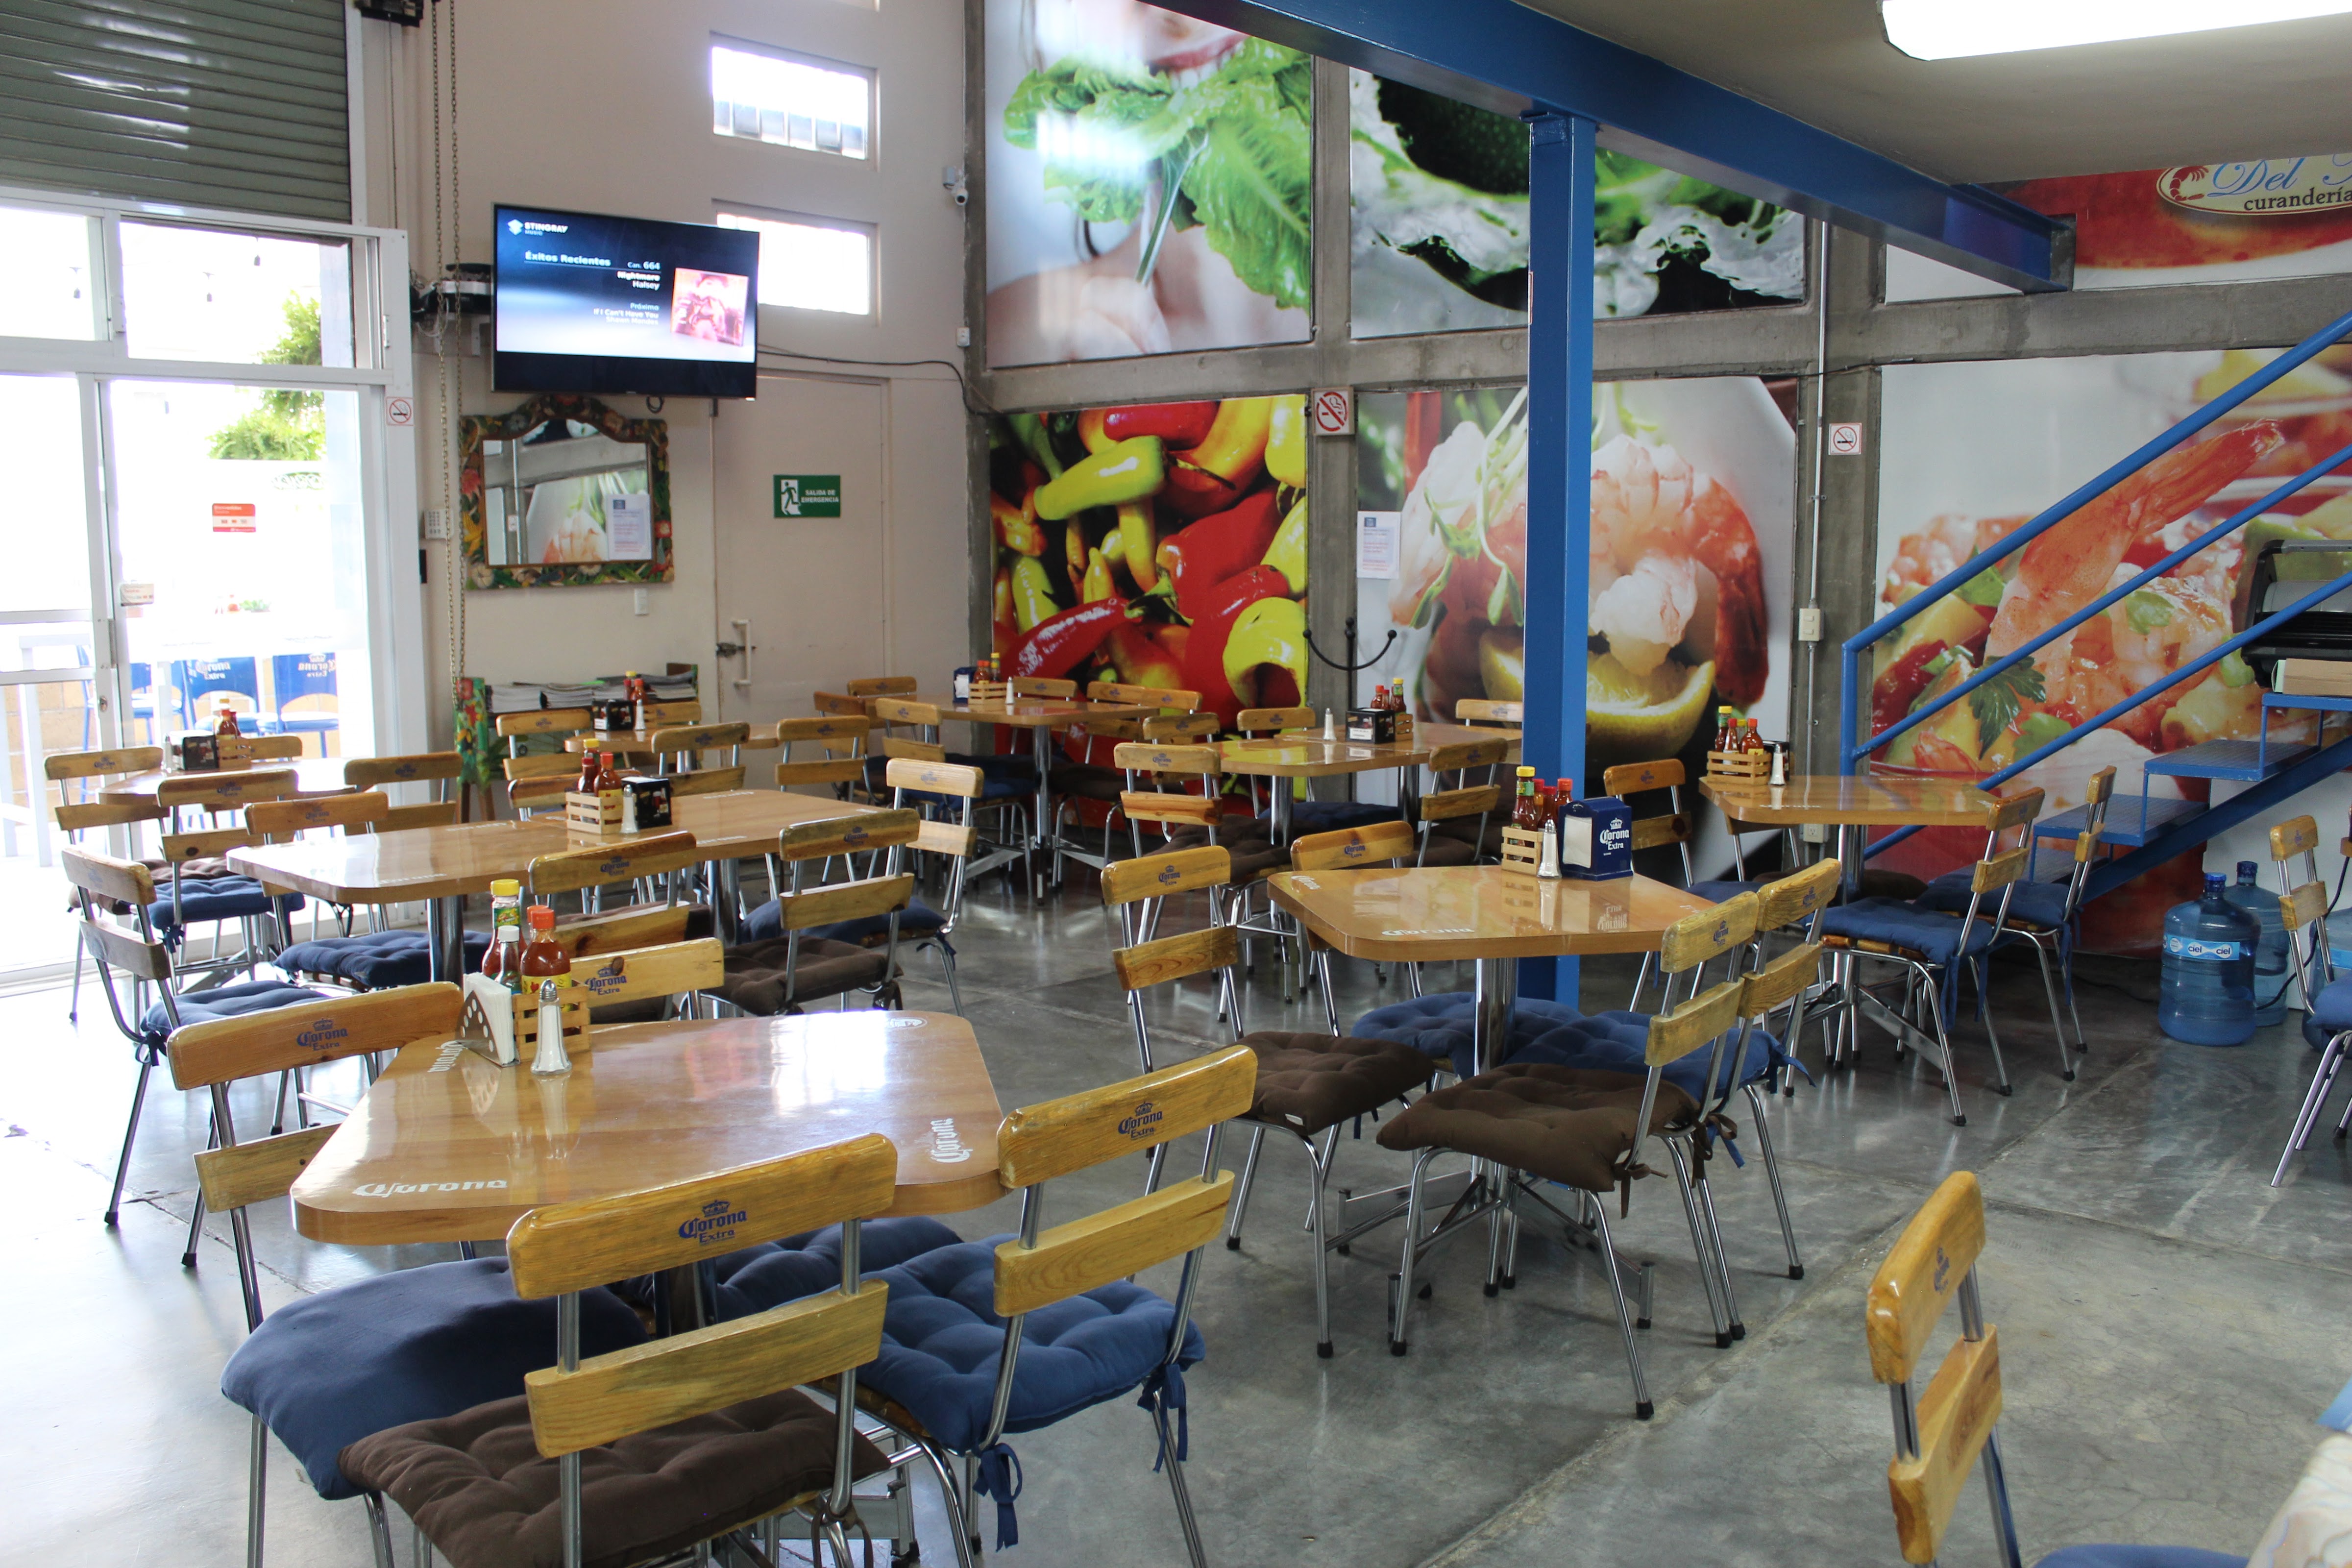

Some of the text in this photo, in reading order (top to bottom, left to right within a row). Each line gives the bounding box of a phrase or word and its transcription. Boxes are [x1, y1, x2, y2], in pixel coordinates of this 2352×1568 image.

[525, 222, 568, 233] STINGRAY
[525, 250, 612, 267] Éxitos Recientes
[643, 261, 661, 270] 664
[617, 270, 661, 281] Nightmare
[633, 280, 660, 291] Halsey
[630, 302, 660, 311] Próximo
[1599, 830, 1630, 845] Corona
[1345, 845, 1366, 855] Corona
[1608, 841, 1624, 850] Extra
[1159, 872, 1180, 882] Corona
[296, 1029, 348, 1047] Corona
[313, 1042, 340, 1051] Extra
[1118, 1111, 1163, 1135] Corona
[1130, 1127, 1155, 1139] Extra
[351, 1179, 508, 1198] Corona
[678, 1210, 747, 1239] Corona
[699, 1229, 735, 1243] Extra
